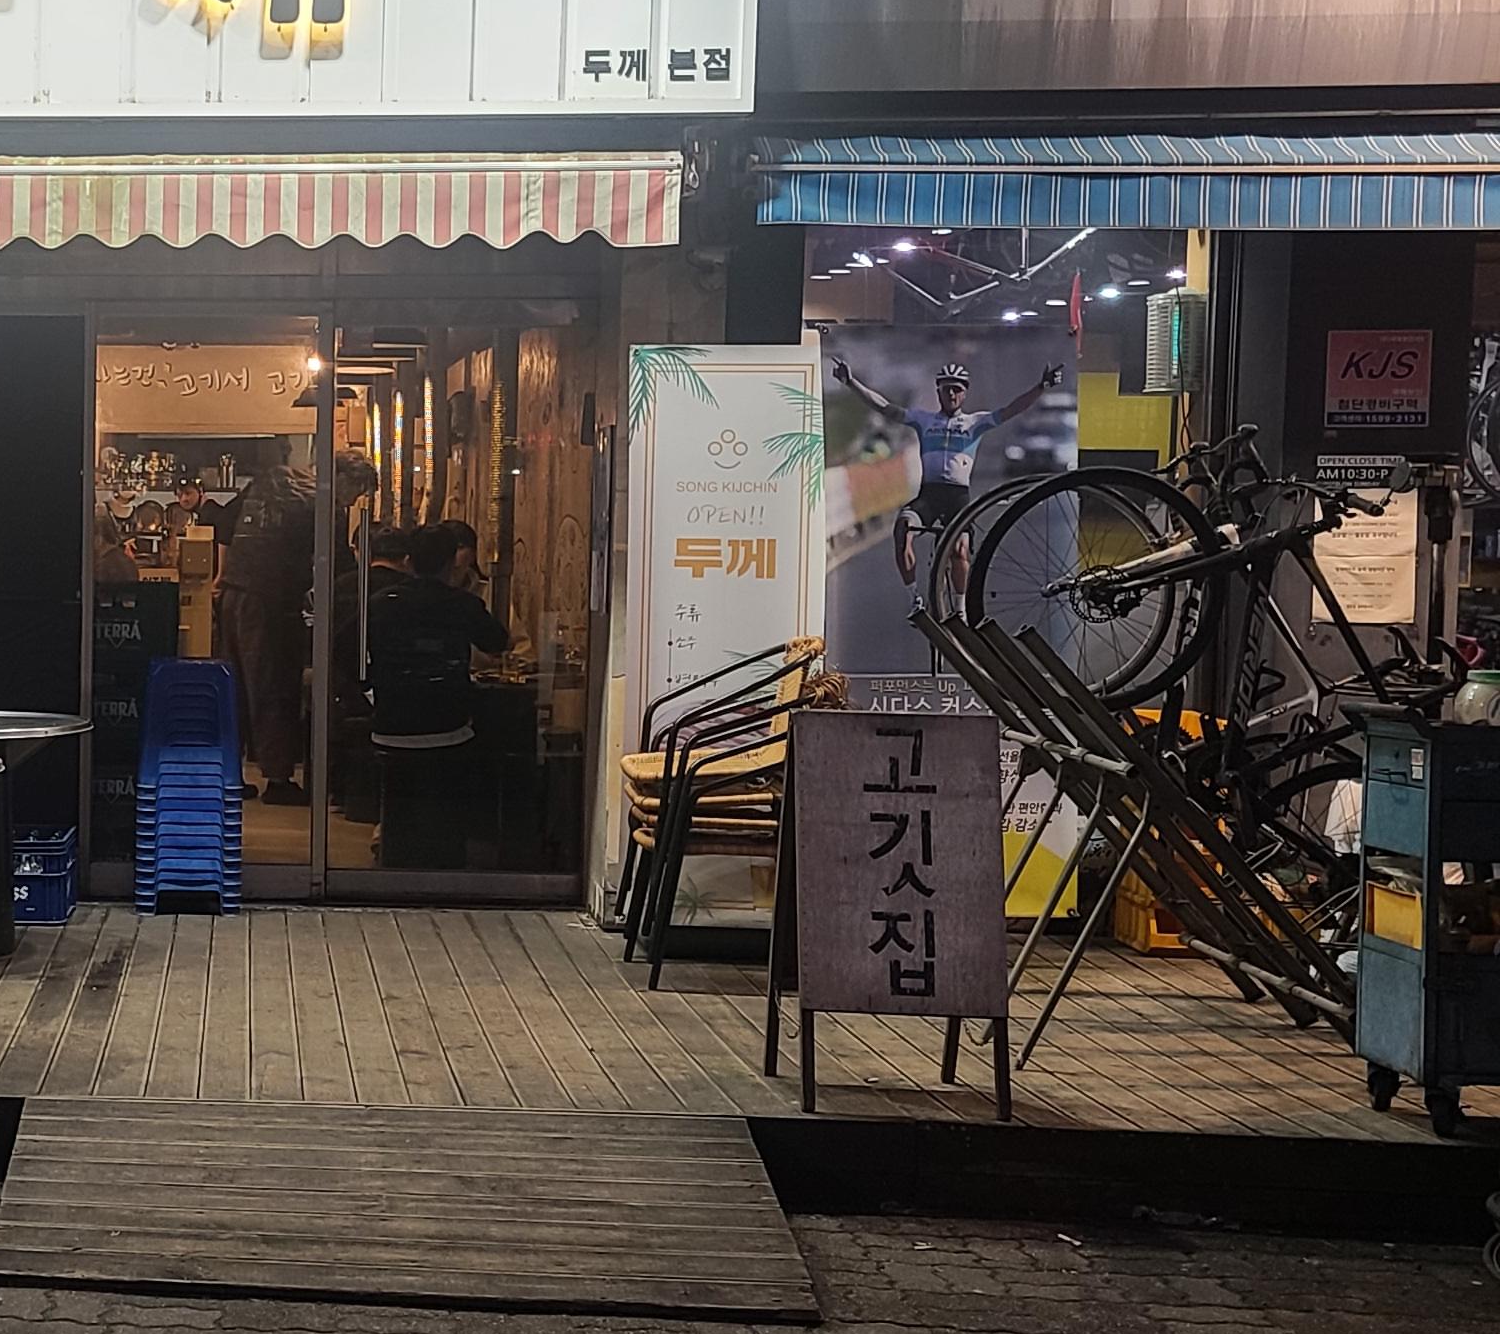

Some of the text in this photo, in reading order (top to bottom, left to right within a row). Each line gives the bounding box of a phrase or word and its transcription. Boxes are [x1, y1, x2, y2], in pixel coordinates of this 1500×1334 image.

[583, 47, 732, 83] 두께 본점
[1340, 351, 1419, 379] KJS
[676, 481, 718, 493] SONG
[674, 538, 778, 579] 두께
[870, 679, 934, 695] 퍼포먼스는
[940, 696, 994, 715] 커스
